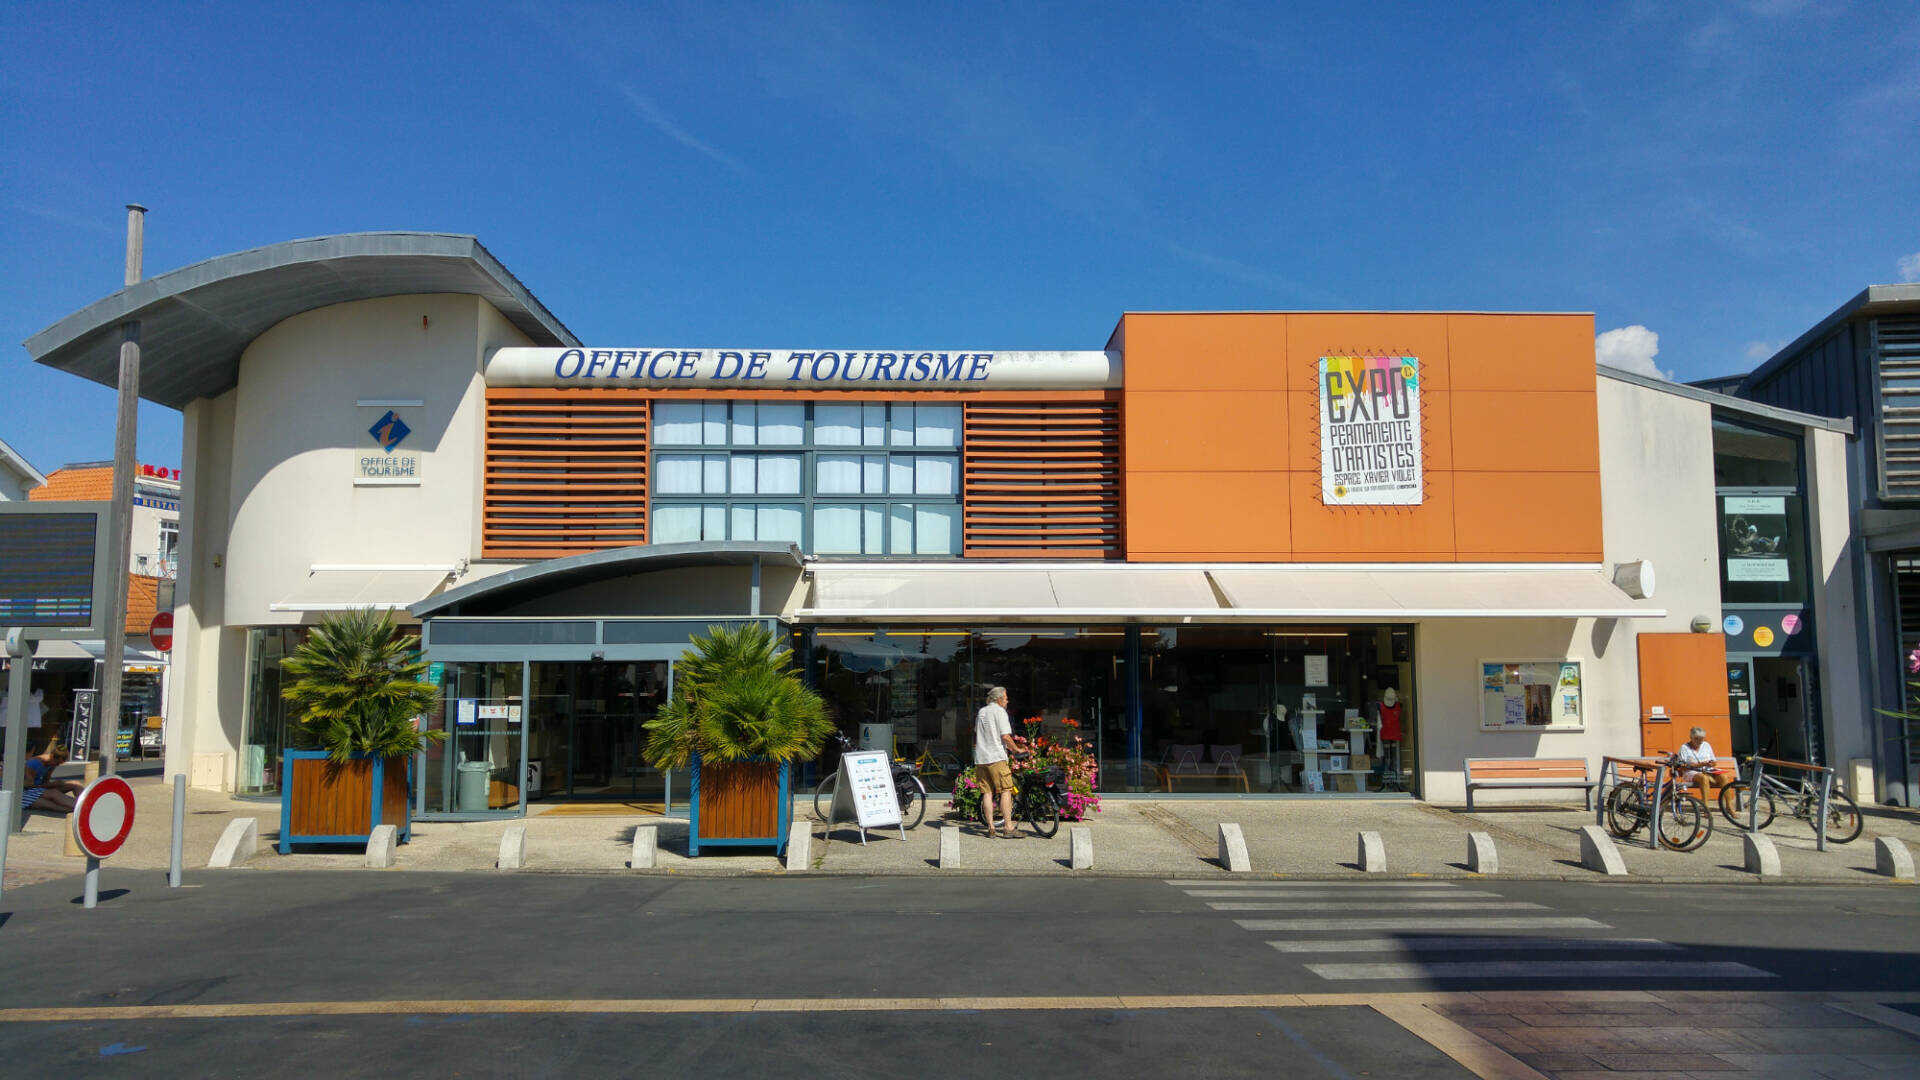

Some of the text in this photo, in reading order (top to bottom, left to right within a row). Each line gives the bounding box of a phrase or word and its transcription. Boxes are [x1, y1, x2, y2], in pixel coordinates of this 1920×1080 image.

[554, 349, 993, 382] OFFICE DE TOURISME
[1325, 367, 1410, 423] EXPO
[1330, 420, 1412, 446] PERMANENTE
[361, 457, 416, 466] OFFICE DE
[1332, 443, 1415, 472] D'ARTISTES
[361, 467, 416, 477] TOURISME
[1334, 472, 1361, 486] ESPACE
[1363, 470, 1389, 484] XAVIER
